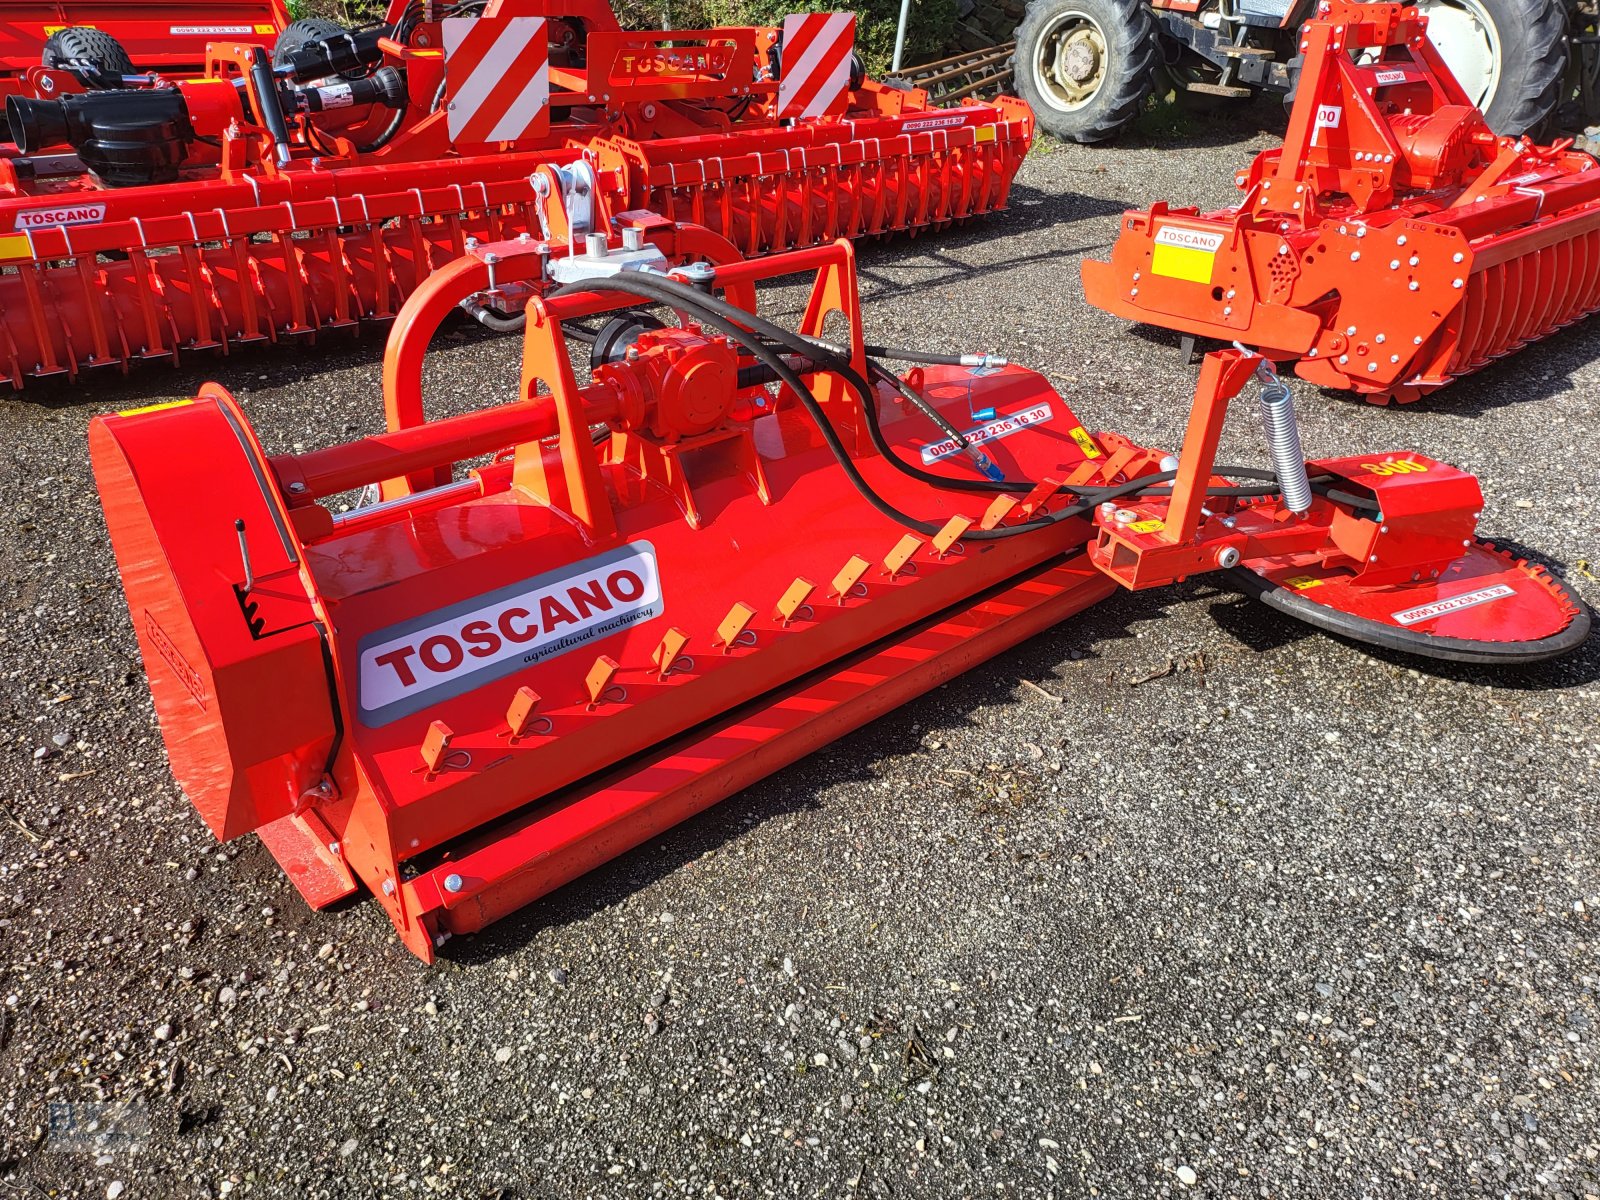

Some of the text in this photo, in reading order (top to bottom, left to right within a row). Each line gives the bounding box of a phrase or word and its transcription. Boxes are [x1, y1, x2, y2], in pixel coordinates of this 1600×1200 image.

[622, 52, 726, 73] TOSCANO
[1378, 72, 1404, 81] TOSCANO
[21, 208, 100, 226] TOSCANO
[1162, 231, 1216, 247] TOSCANO
[964, 430, 988, 444] 222
[988, 421, 1012, 435] 236
[1013, 415, 1029, 426] 16
[1030, 409, 1046, 421] 30
[1360, 459, 1428, 476] 800
[1403, 608, 1433, 620] 0090
[1432, 602, 1457, 612] 222
[1455, 595, 1478, 605] 236
[1477, 591, 1493, 599] 16
[374, 569, 645, 687] TOSCANO
[523, 607, 655, 663] agricultural machinery
